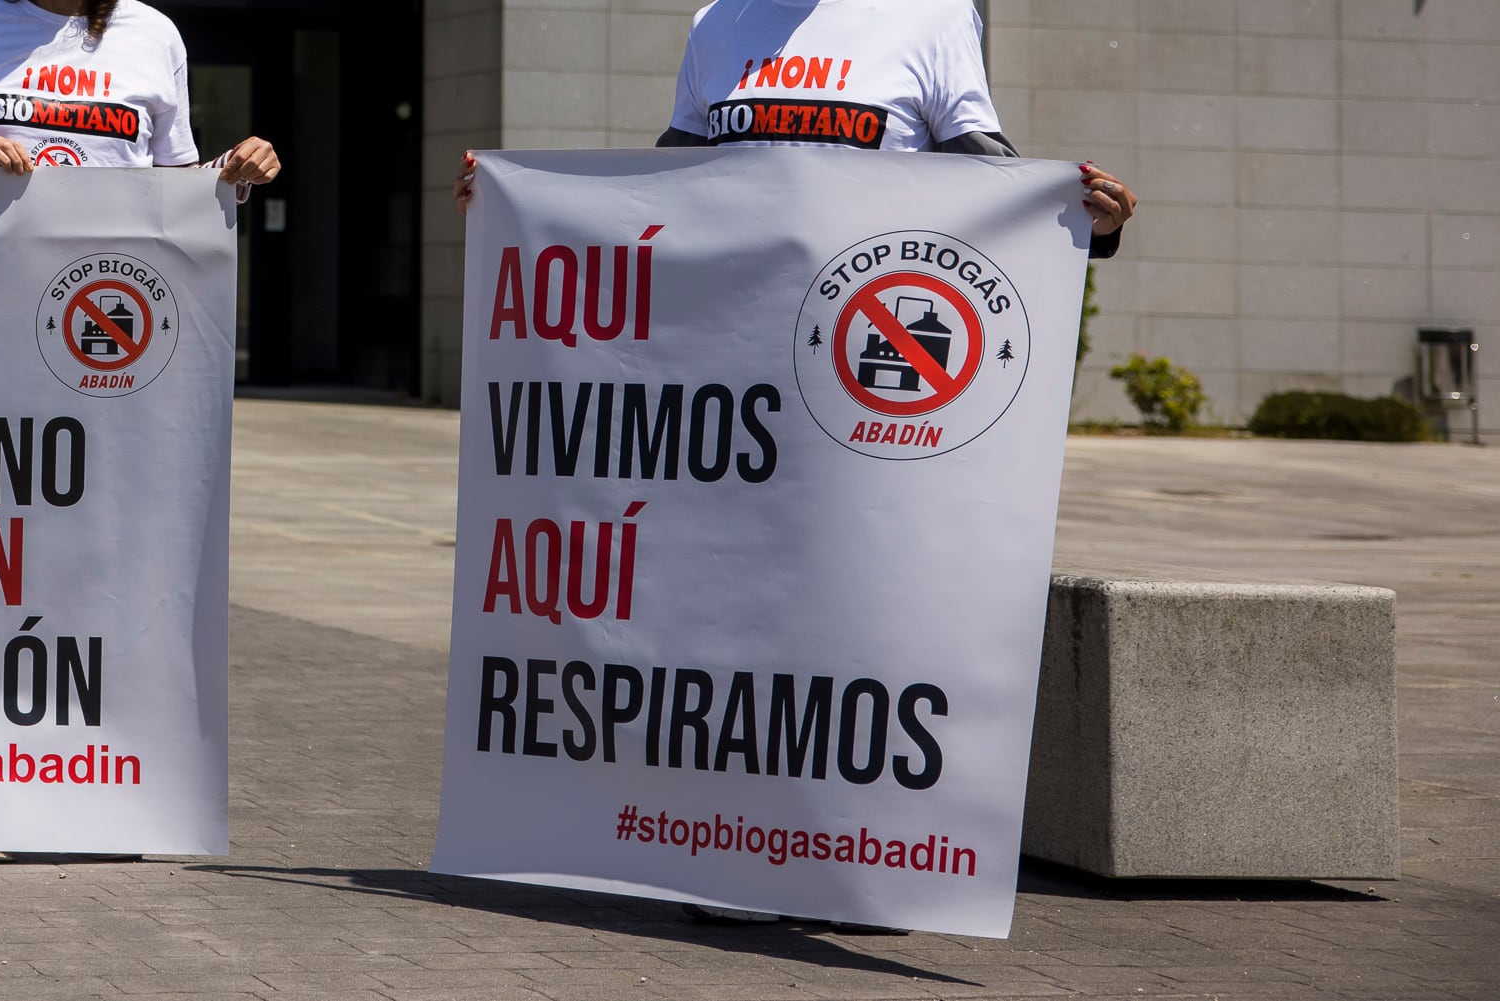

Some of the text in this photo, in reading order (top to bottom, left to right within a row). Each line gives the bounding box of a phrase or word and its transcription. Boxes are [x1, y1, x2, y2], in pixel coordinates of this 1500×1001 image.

[30, 136, 88, 162] STOP BIOMETANO
[707, 103, 880, 143] BIOMETANO
[50, 263, 94, 301] STOP
[488, 224, 665, 348] AQUÍ
[819, 243, 892, 301] STOP
[78, 371, 135, 389] ABADÍN
[488, 381, 782, 484] VIVIMOS
[848, 419, 943, 449] ABADÍN
[482, 500, 647, 626] AQUÍ
[476, 655, 950, 791] RESPIRAMOS
[616, 803, 978, 878] #stopbiogasabadin
